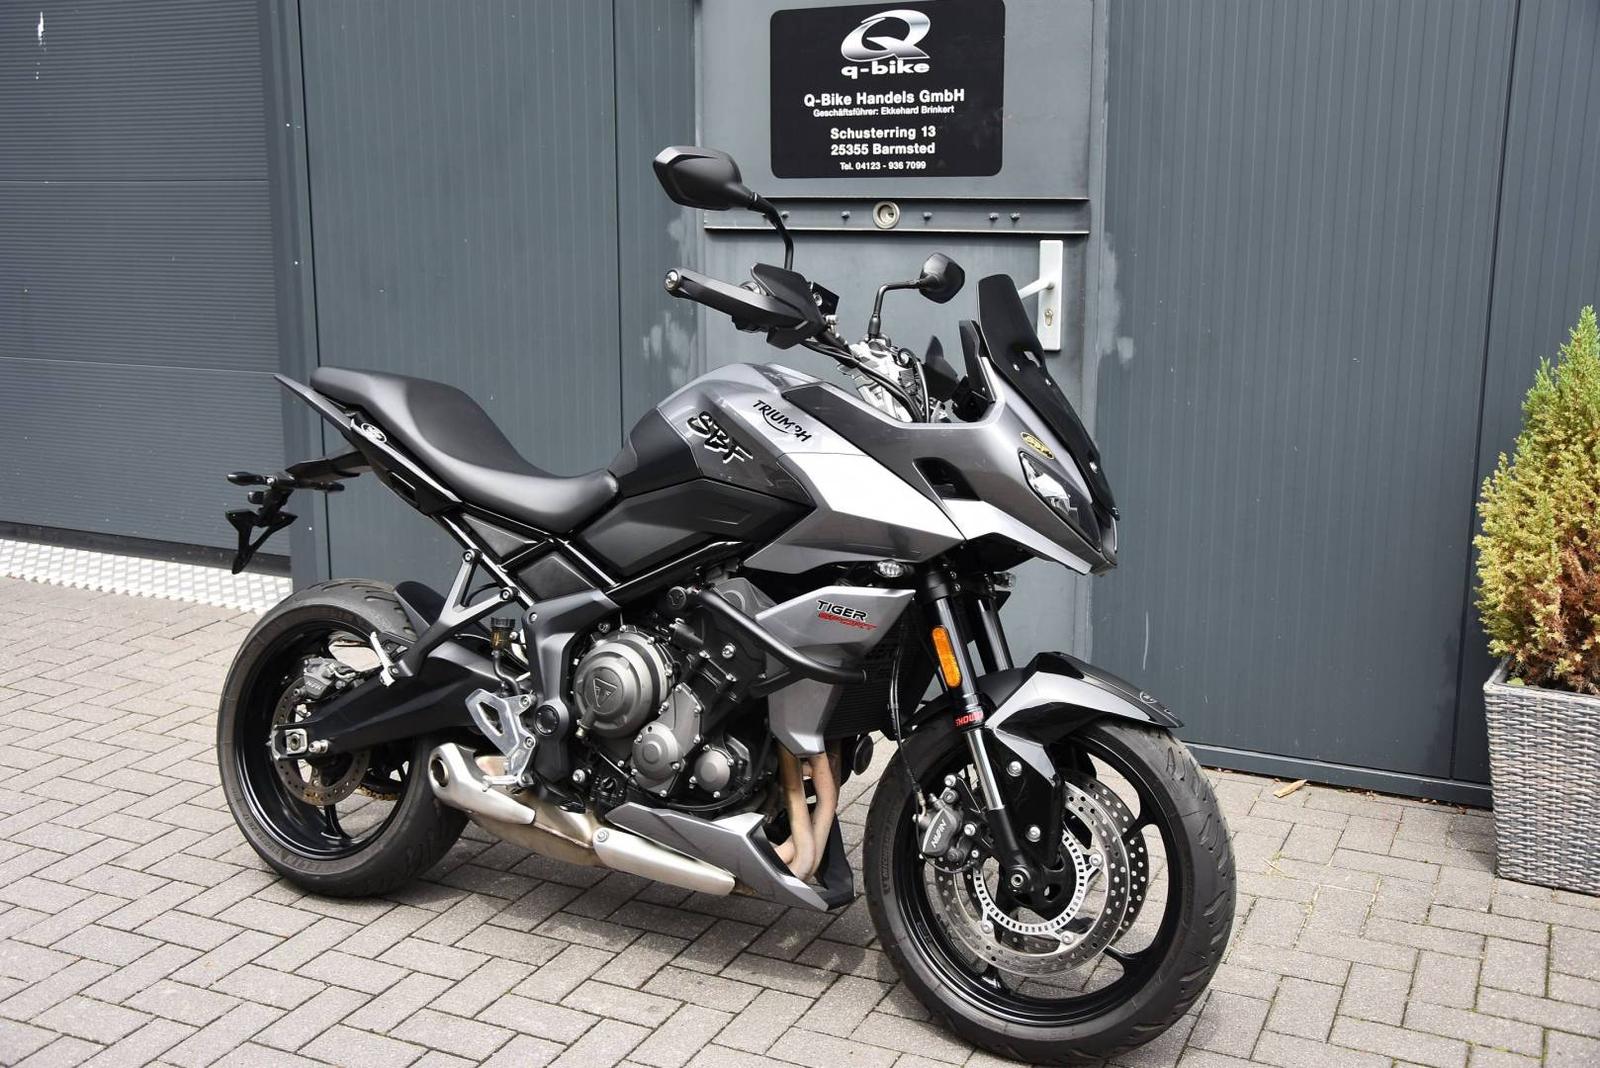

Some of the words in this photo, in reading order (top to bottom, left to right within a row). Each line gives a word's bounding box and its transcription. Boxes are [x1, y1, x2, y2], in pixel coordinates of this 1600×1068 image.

[841, 60, 930, 80] q-bike
[804, 93, 852, 107] Q-Bike
[856, 91, 915, 104] Handels
[919, 89, 965, 103] GmbH
[812, 106, 879, 118] Geschäftsführer:
[880, 106, 919, 116] Ekkehard
[921, 105, 955, 115] Brinkert
[830, 127, 917, 140] Schusterring
[921, 126, 936, 138] 13
[830, 144, 869, 156] 25355
[872, 142, 936, 155] Barmsted
[840, 162, 853, 171] Tel.
[855, 162, 881, 171] 04123
[888, 161, 904, 170] 936
[905, 161, 926, 170] 7099
[753, 399, 812, 442] TRIUMPH
[817, 599, 867, 622] TIGER
